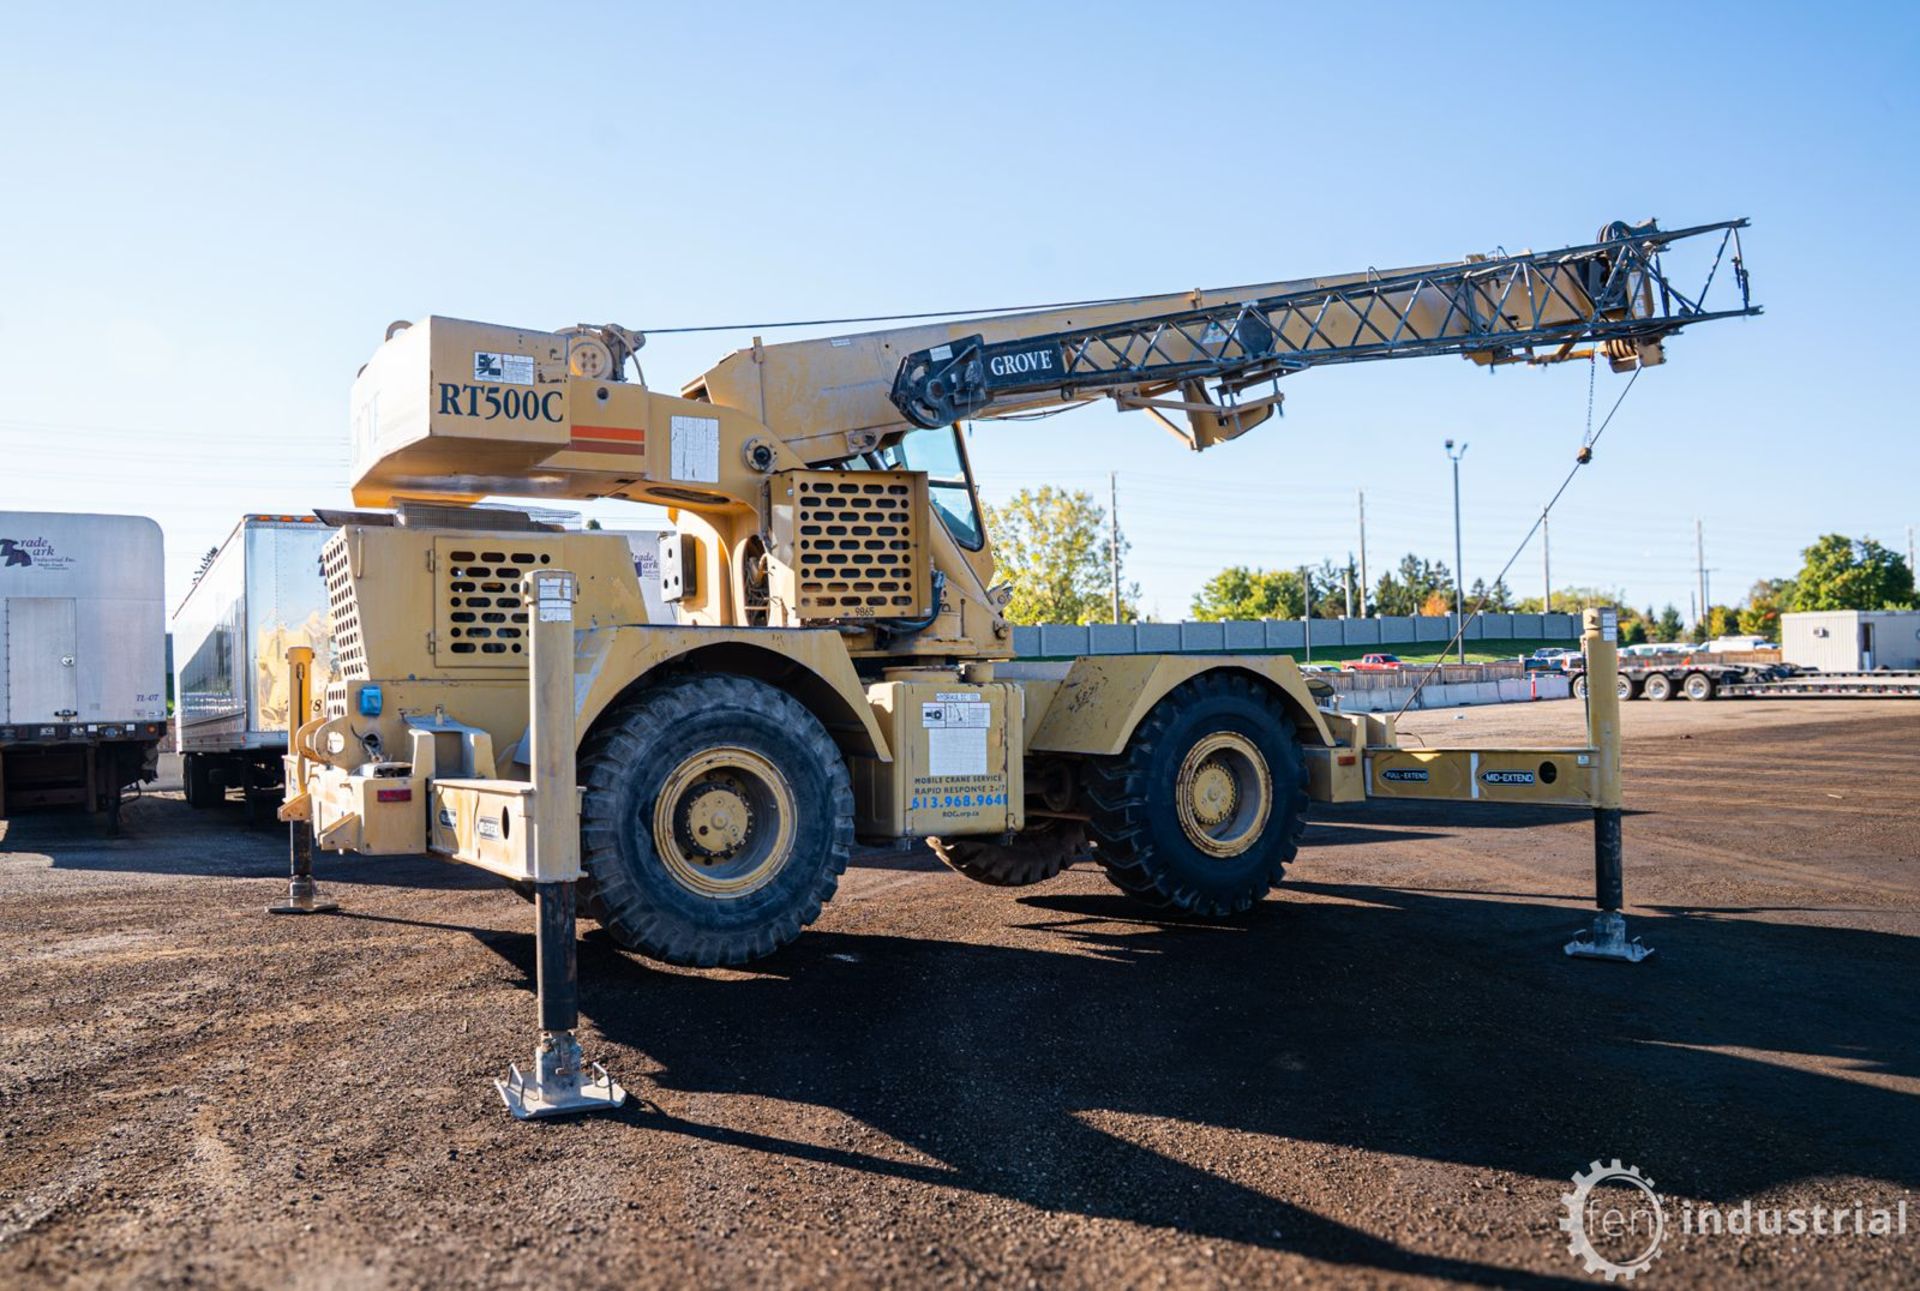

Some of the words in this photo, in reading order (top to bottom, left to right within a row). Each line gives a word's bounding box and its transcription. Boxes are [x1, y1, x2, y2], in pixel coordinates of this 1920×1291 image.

[990, 350, 1052, 376] GROVE
[437, 382, 564, 423] RT500C
[914, 776, 942, 785] MOBILE
[945, 775, 971, 783] CRANE
[973, 774, 1003, 782] SERVICE
[1486, 773, 1534, 782] MID-EXTEND
[914, 786, 942, 795] RAPID
[944, 785, 986, 794] RESPONSE
